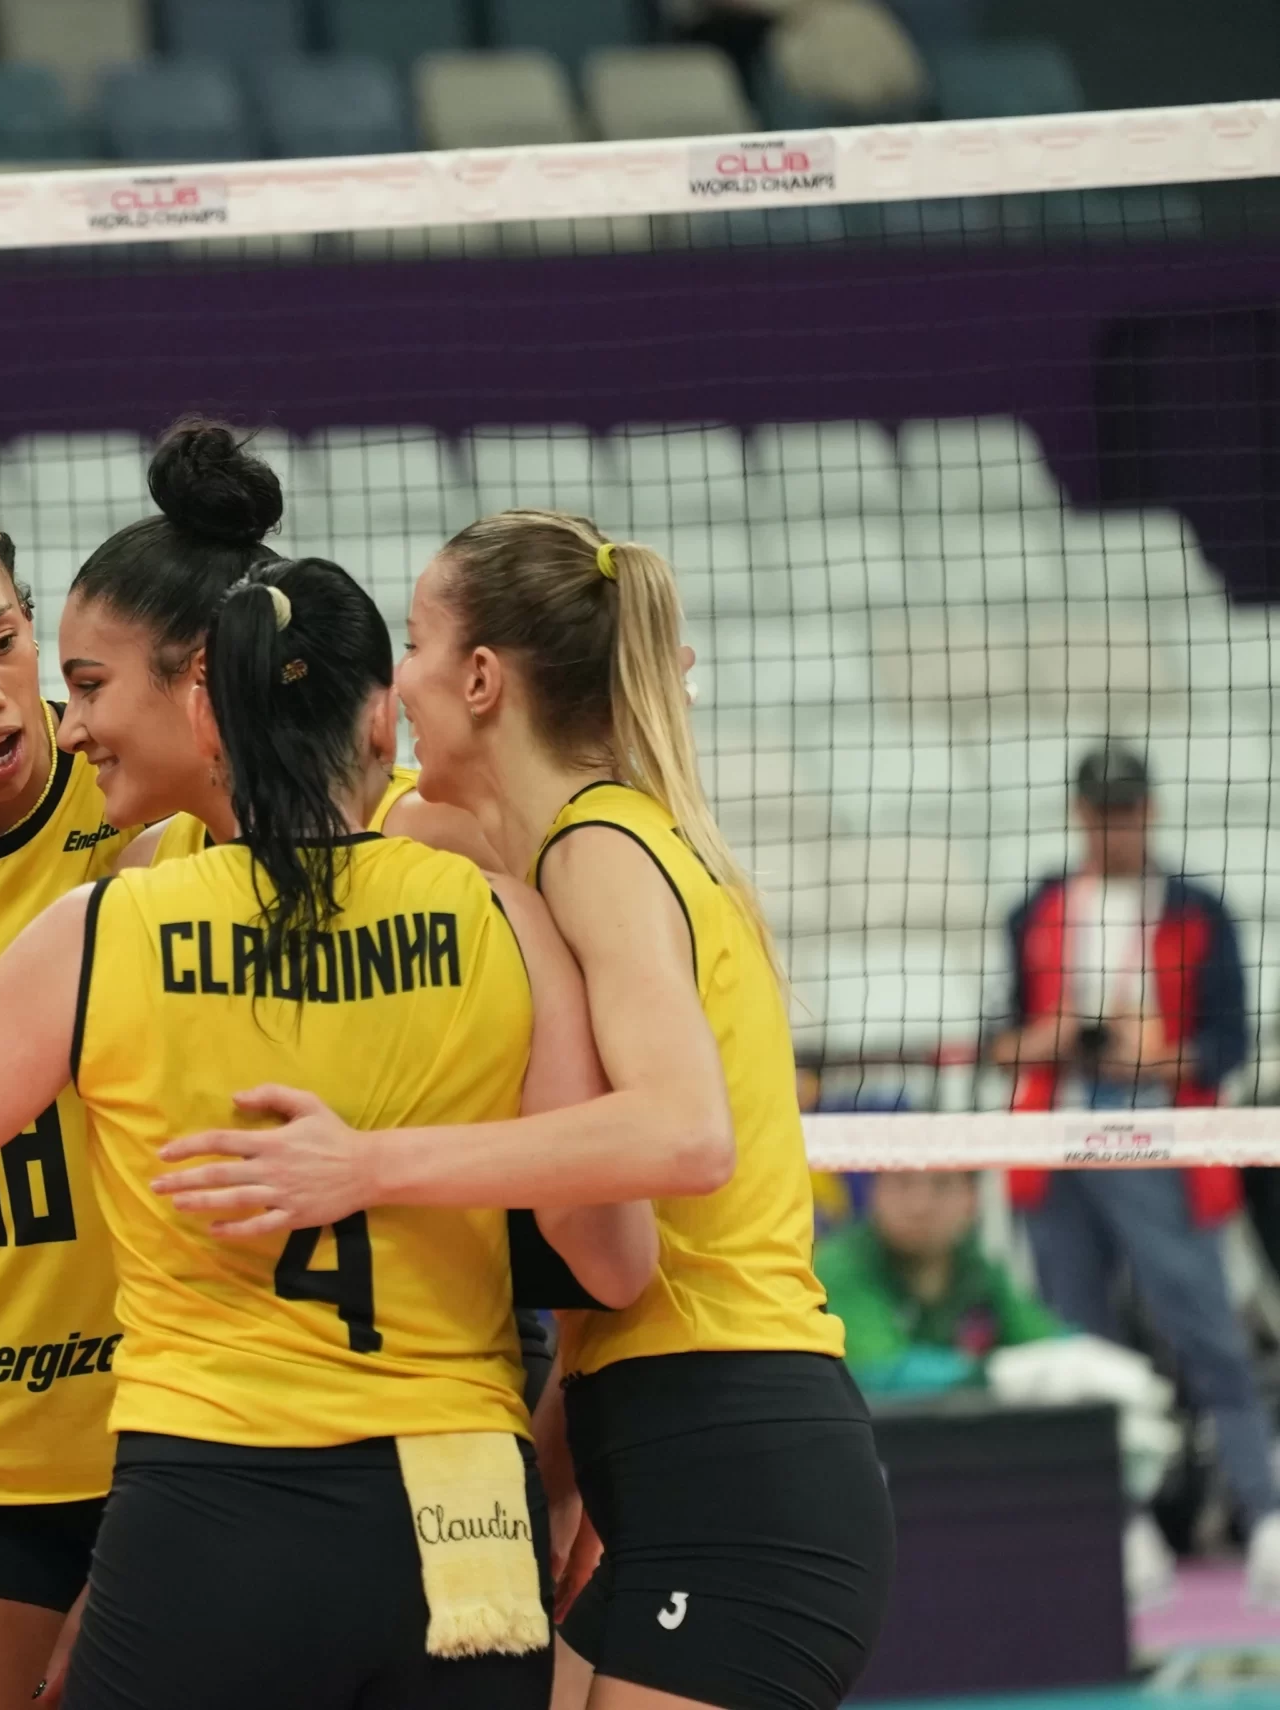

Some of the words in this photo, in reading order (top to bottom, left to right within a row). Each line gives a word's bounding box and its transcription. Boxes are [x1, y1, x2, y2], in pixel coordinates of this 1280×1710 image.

[716, 152, 810, 175] CLUB
[690, 178, 757, 195] WORLD
[761, 174, 836, 193] CHAMPS
[274, 1210, 383, 1355] 4
